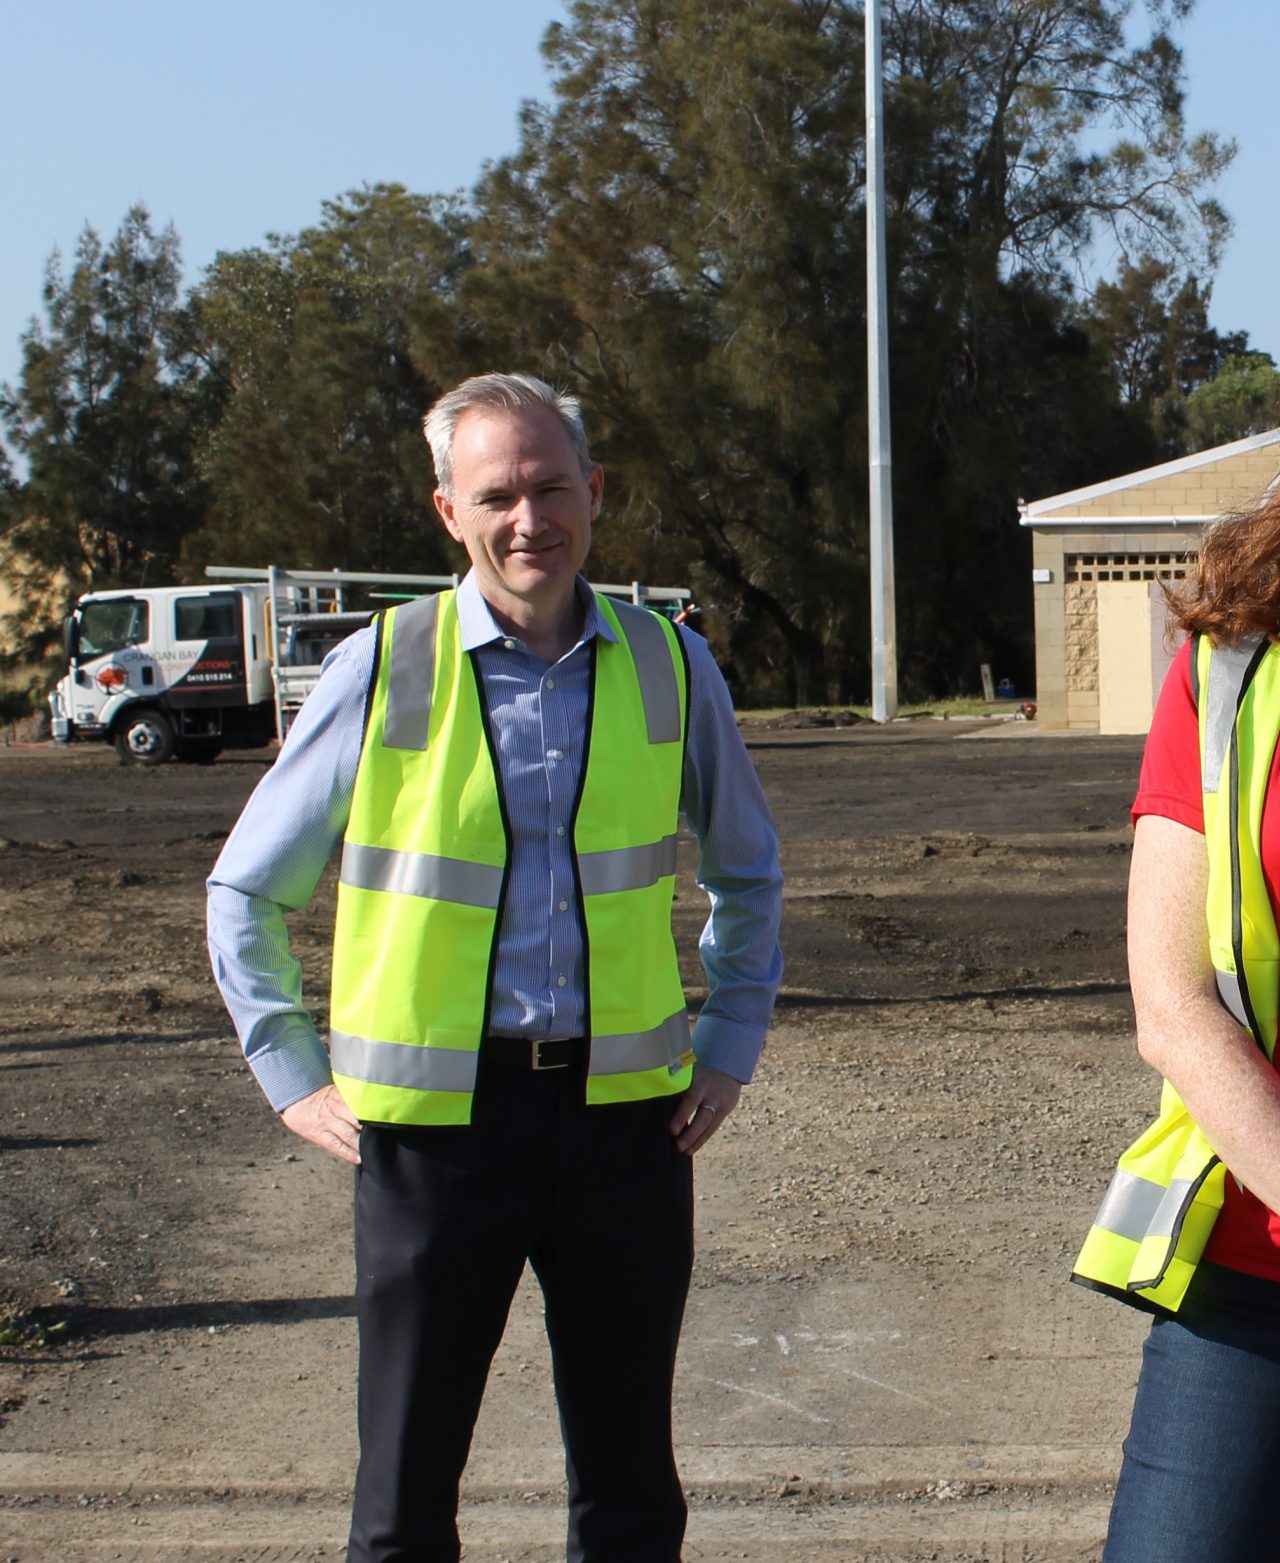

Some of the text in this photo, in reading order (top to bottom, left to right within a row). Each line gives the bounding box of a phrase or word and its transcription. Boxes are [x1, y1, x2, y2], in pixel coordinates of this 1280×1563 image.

[123, 650, 199, 662] CRANGAN BAY
[186, 673, 204, 682] 0410
[219, 672, 232, 681] 214
